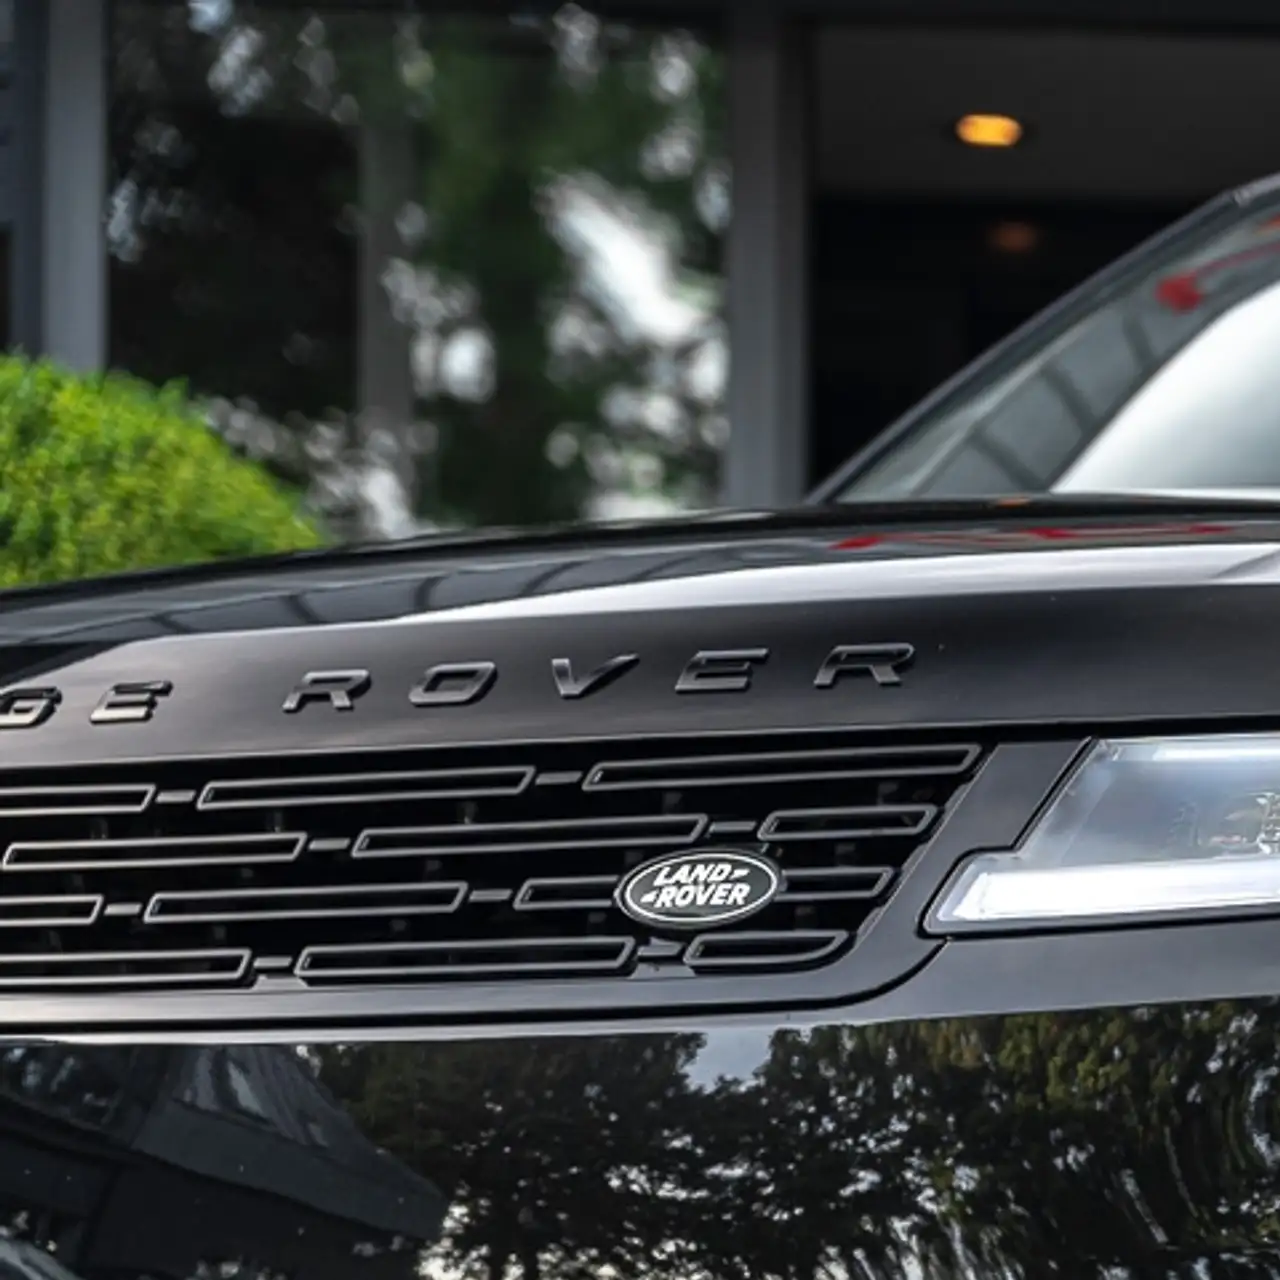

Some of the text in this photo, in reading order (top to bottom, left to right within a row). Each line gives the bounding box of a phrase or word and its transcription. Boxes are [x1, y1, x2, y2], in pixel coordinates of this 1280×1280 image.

[281, 642, 916, 713] ROVER
[653, 863, 732, 887] LAND
[653, 883, 751, 909] ROVER
